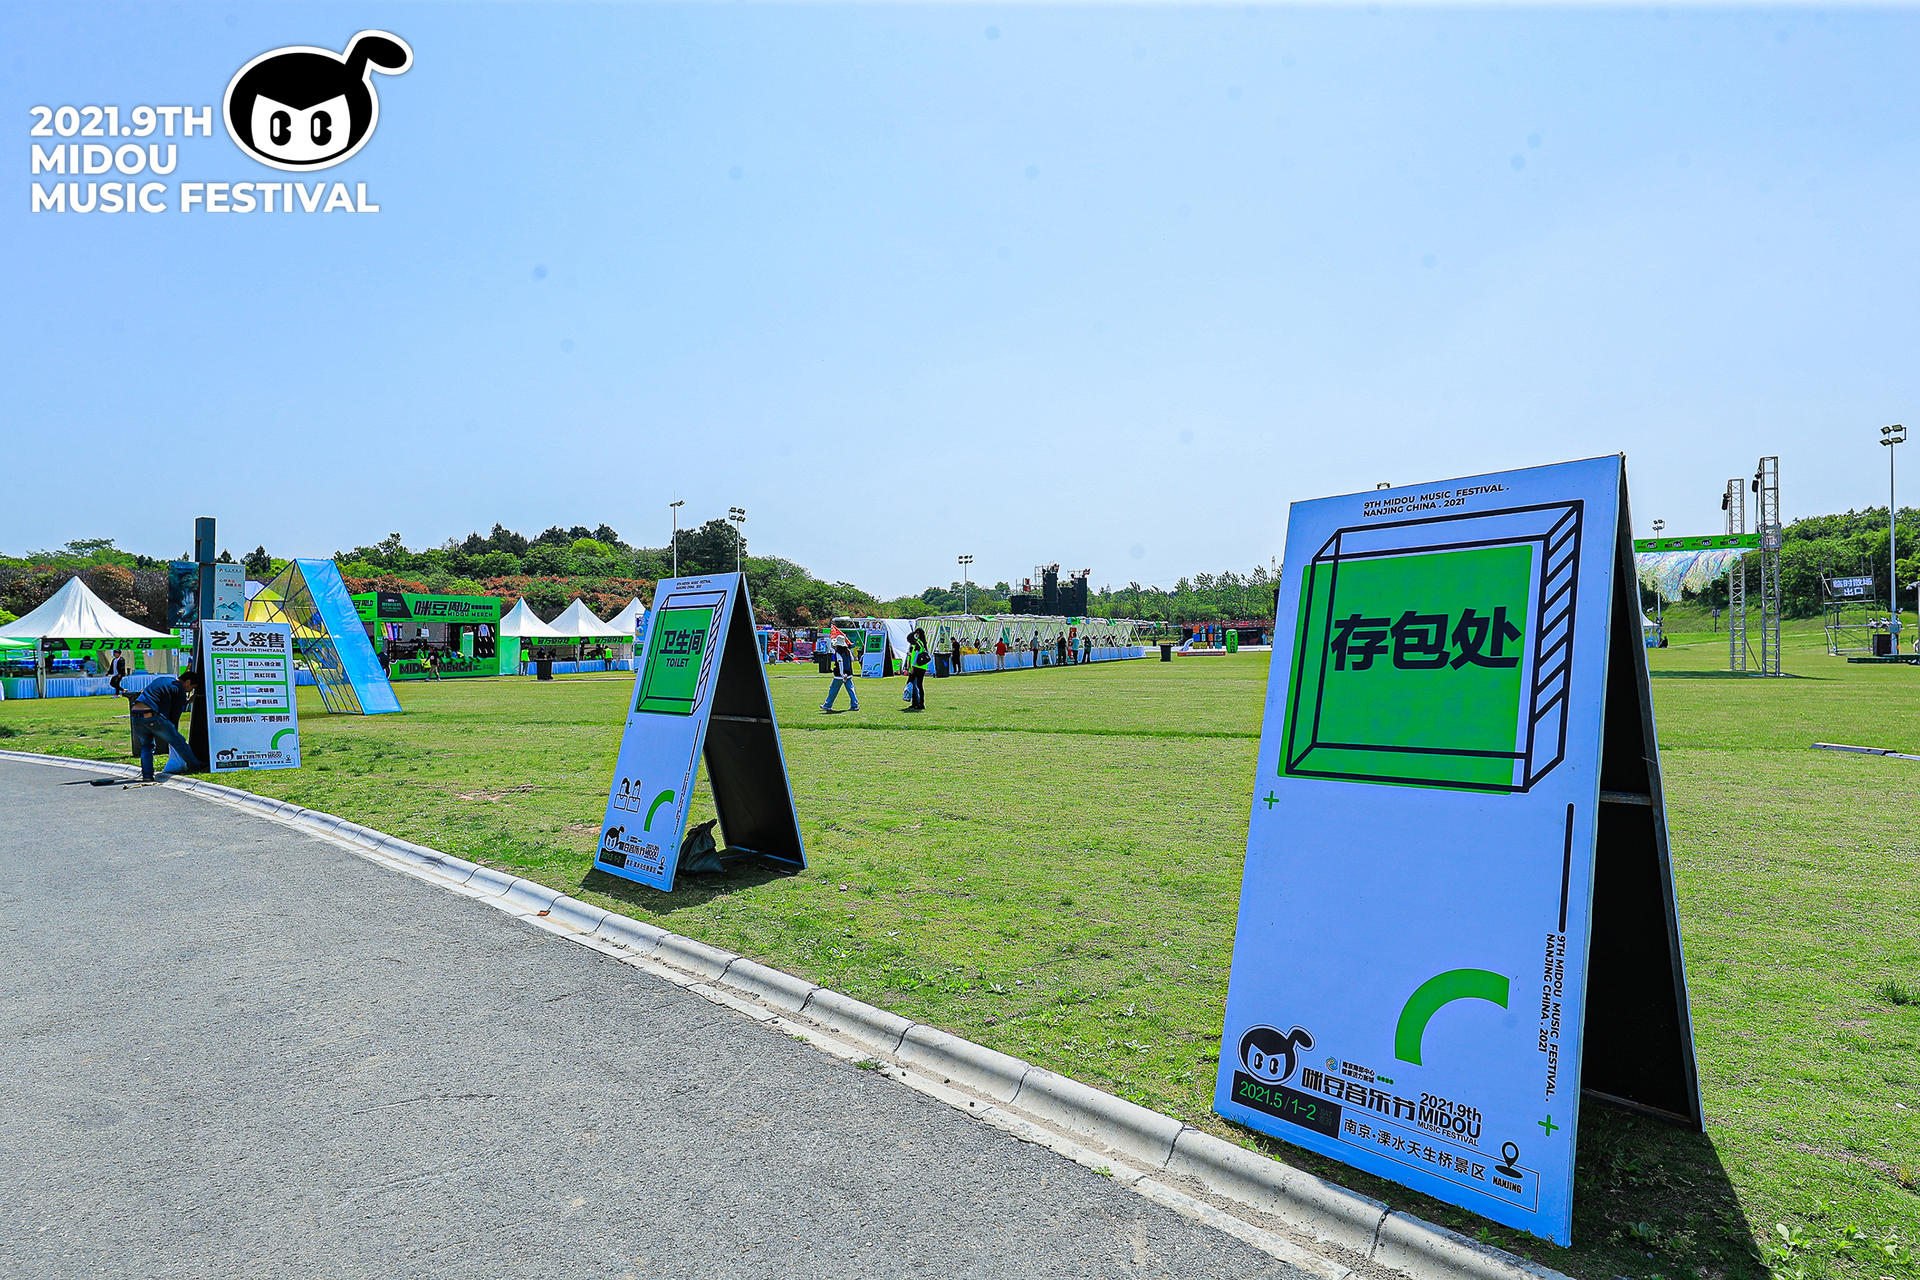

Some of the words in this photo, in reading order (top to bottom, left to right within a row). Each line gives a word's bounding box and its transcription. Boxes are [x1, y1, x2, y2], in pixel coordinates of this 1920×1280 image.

[1363, 506, 1403, 517] NANJING
[1444, 498, 1465, 508] 2021
[1364, 501, 1381, 509] 9TH
[1383, 496, 1415, 506] MIDOU
[1420, 490, 1451, 502] MUSIC
[1843, 587, 1864, 596] 出口
[80, 639, 152, 650] 官方饮品
[210, 631, 285, 648] 艺人签售
[659, 628, 706, 655] 卫生间
[1330, 606, 1522, 671] 存包处
[666, 658, 689, 668] TOILET
[1543, 934, 1555, 983] NANJING
[1556, 935, 1566, 957] 9TH
[1554, 959, 1564, 998] MIDOU
[1550, 1002, 1561, 1039] MUSIC
[1538, 1029, 1548, 1053] 2021
[1301, 1067, 1416, 1121] 咪豆音乐节
[1420, 1092, 1482, 1123] 2021.9th
[1417, 1121, 1441, 1134] MUSIC
[1441, 1129, 1479, 1147] FESTIVAL
[1418, 1105, 1481, 1138] MIDOU
[1493, 1176, 1522, 1194] NANJING
